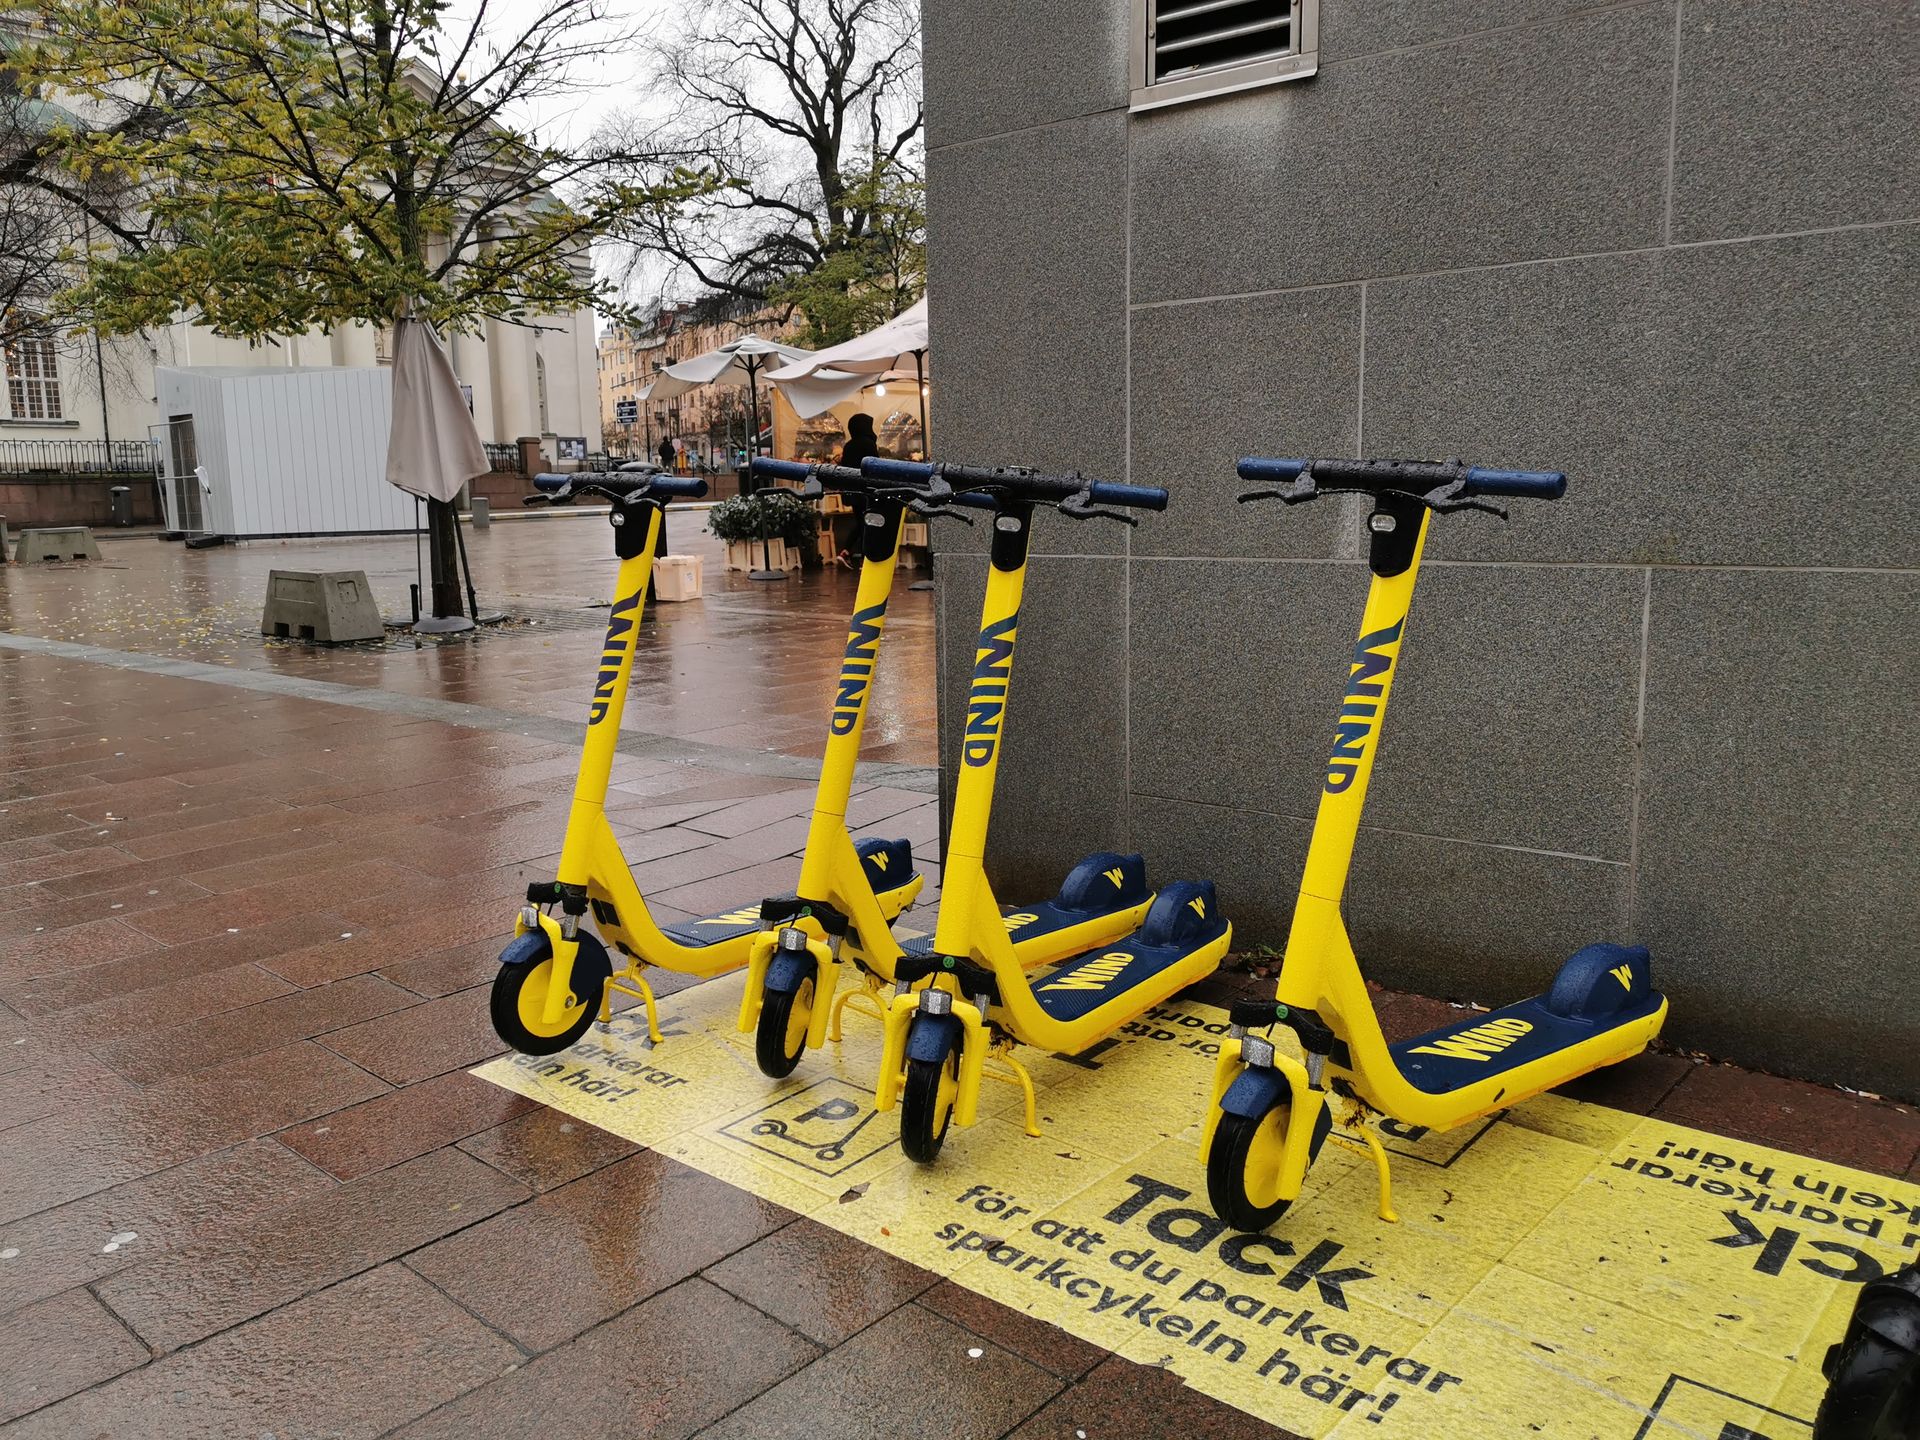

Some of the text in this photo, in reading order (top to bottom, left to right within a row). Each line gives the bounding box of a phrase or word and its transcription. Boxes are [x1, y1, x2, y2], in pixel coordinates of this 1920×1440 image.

[588, 586, 643, 726] WIND
[831, 597, 889, 736] WIND
[964, 611, 1020, 768] WIND
[1324, 614, 1405, 795] WIND
[867, 850, 889, 871] W
[1102, 867, 1124, 890] W
[1187, 896, 1205, 919] W
[1037, 952, 1134, 992] WIND
[1609, 963, 1633, 993] W
[1407, 1018, 1534, 1062] WIND
[559, 1068, 639, 1103] här!
[571, 1044, 689, 1090] arkerar
[1655, 1141, 1776, 1188] här!
[1611, 1157, 1884, 1238] parkerar
[1103, 1173, 1377, 1312] Tack
[955, 1184, 1463, 1393] för att du parkerar
[933, 1222, 1401, 1424] sparkcykeln här!
